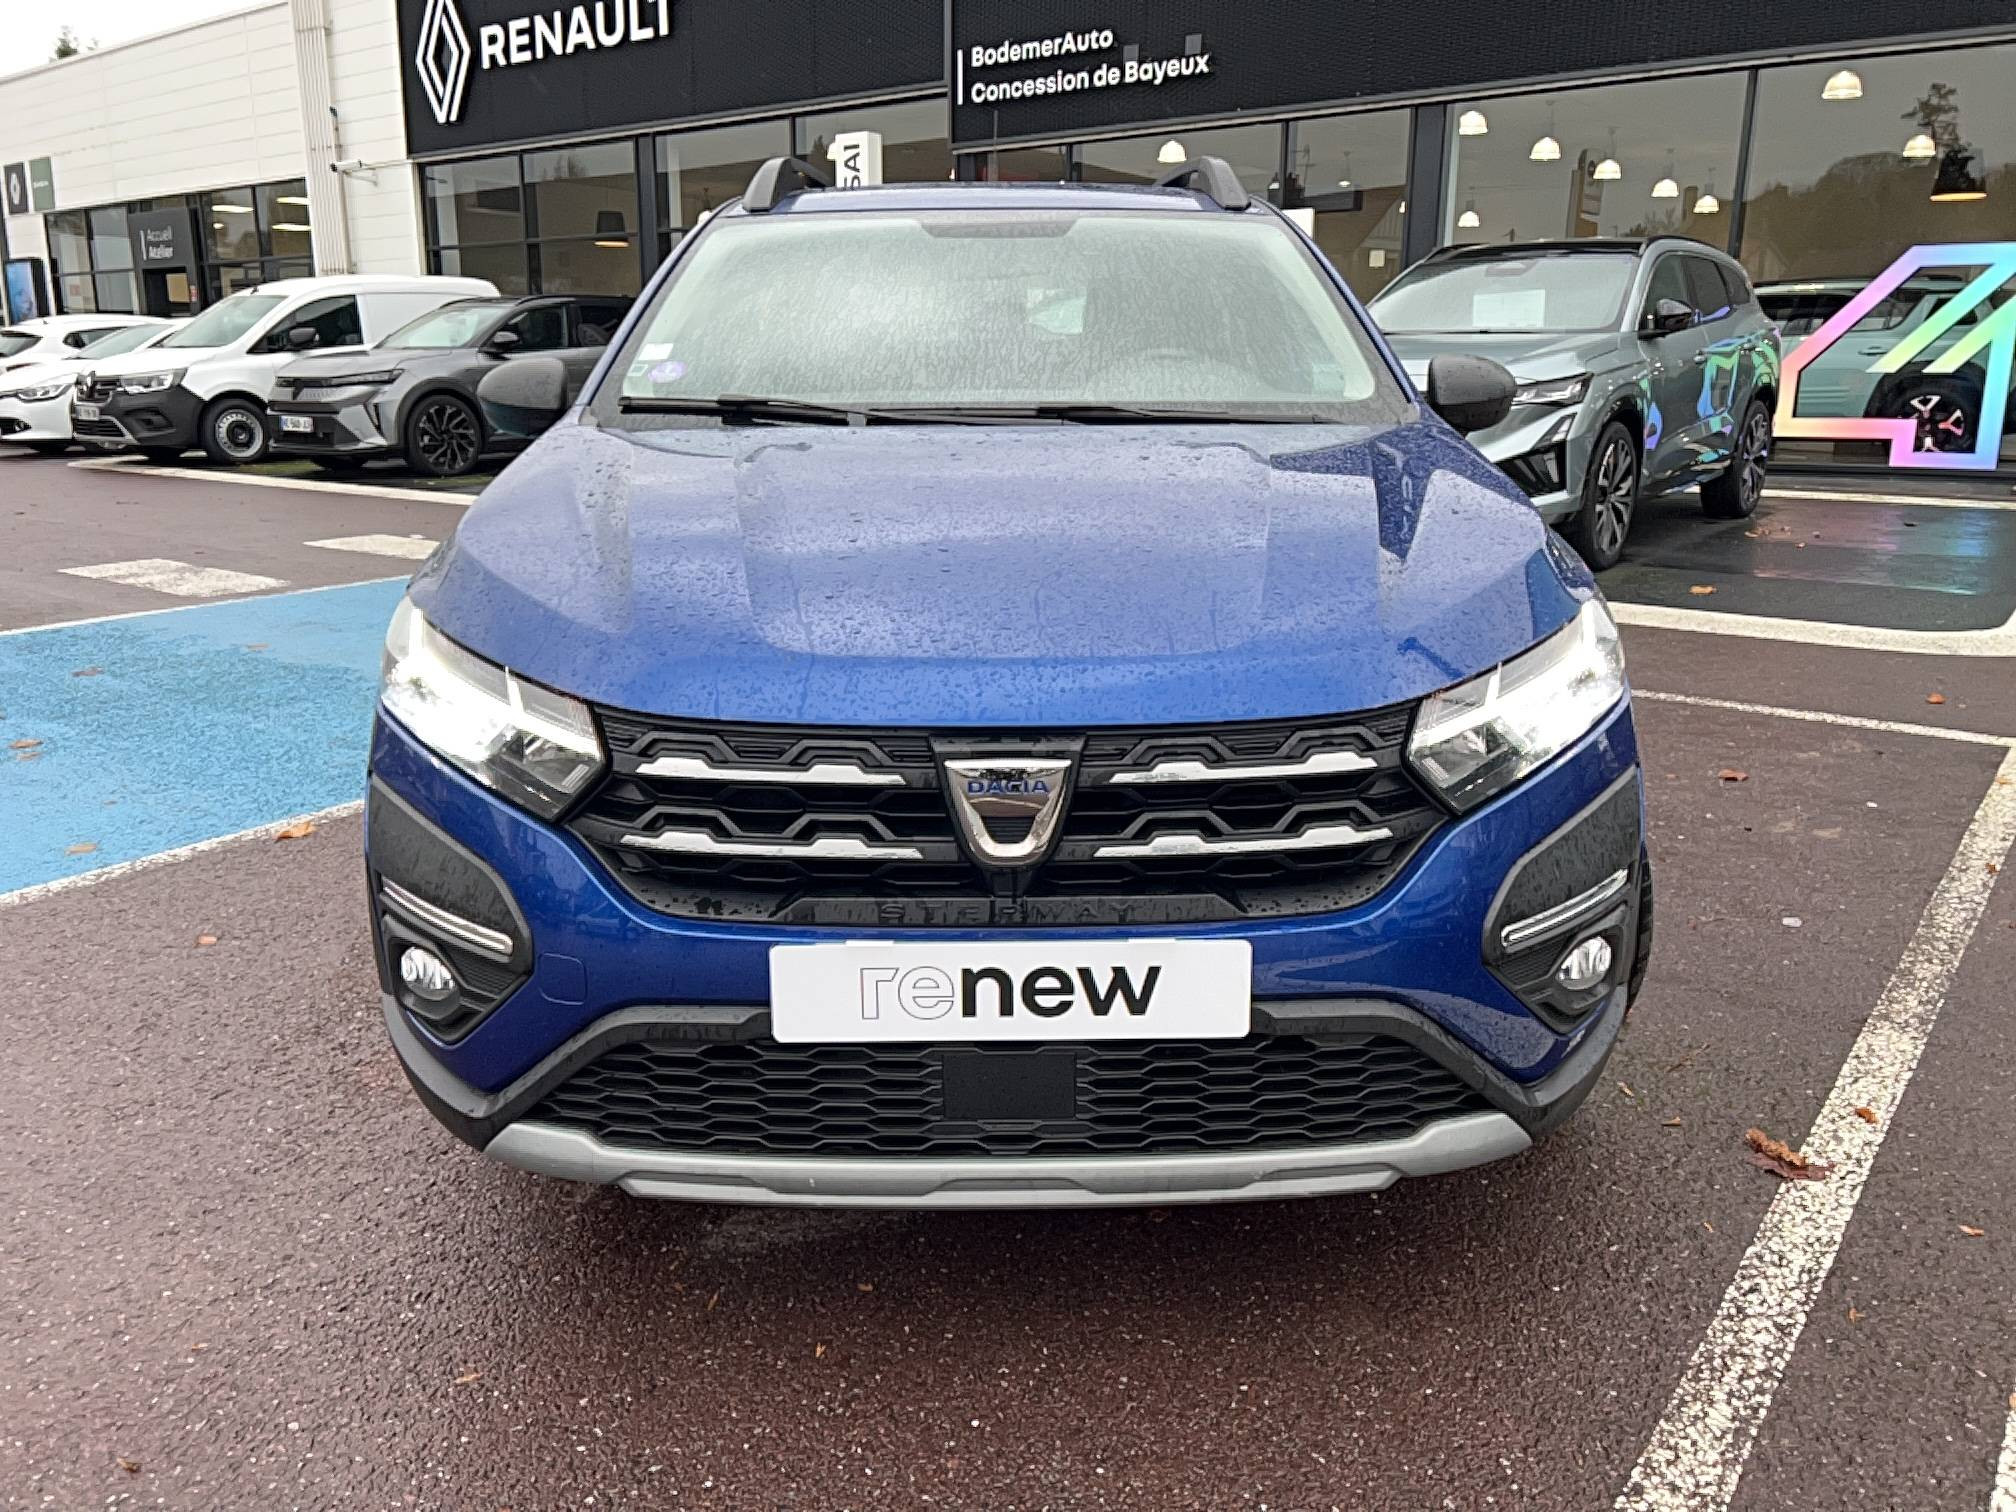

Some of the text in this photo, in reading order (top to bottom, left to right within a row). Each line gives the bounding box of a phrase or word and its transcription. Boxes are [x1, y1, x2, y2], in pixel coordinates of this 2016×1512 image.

[479, 0, 670, 70] RENAULT
[971, 29, 1114, 67] BodemerAuto
[971, 53, 1210, 103] Concession de Bayeux
[967, 779, 1049, 794] DACIA
[860, 965, 1163, 1020] renew
